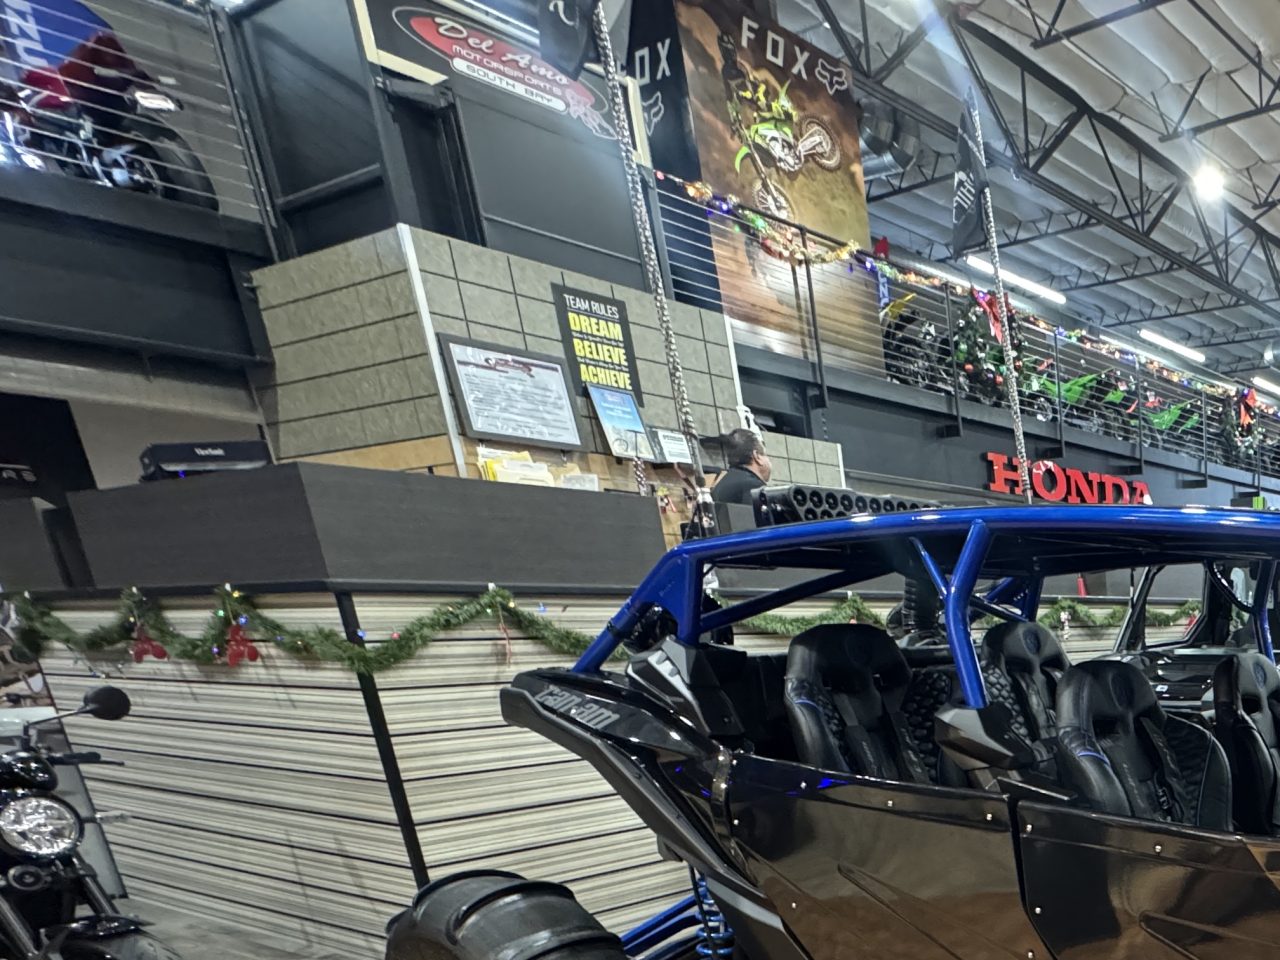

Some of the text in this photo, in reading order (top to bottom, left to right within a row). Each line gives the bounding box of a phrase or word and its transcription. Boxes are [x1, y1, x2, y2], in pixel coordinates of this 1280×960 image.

[433, 16, 569, 85] Del Amo
[452, 44, 563, 96] MOTORSPORTS
[617, 38, 671, 87] OX
[741, 16, 810, 80] FOX
[466, 64, 553, 104] SOUTH BAY
[562, 293, 620, 319] TEAM RULES
[567, 311, 624, 342] DREAM
[572, 337, 629, 367] BELIEVE
[580, 363, 633, 390] ACHIEVE
[986, 451, 1153, 505] HONDA
